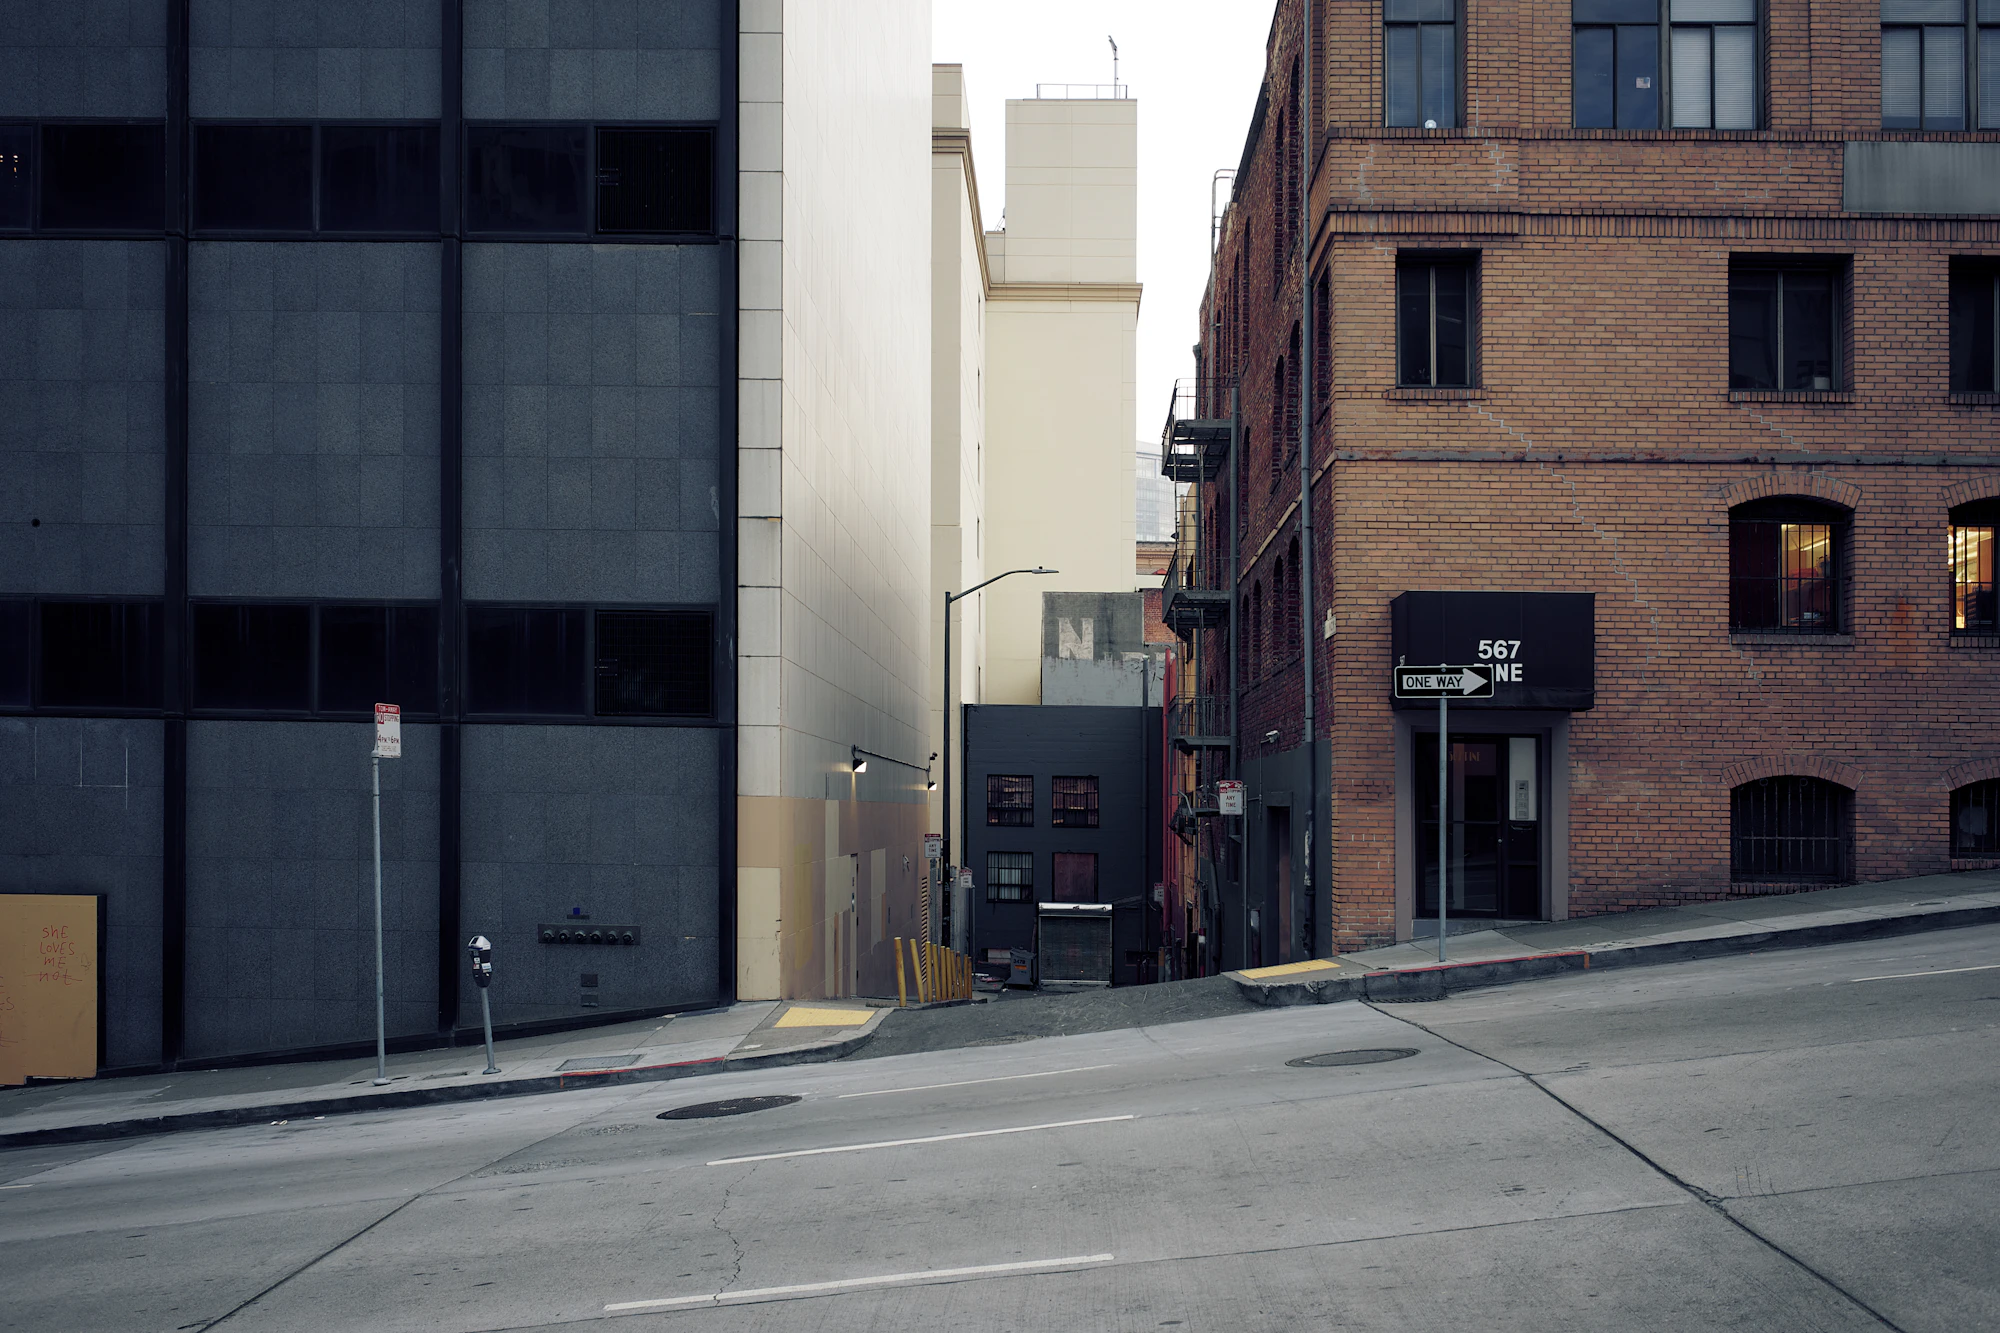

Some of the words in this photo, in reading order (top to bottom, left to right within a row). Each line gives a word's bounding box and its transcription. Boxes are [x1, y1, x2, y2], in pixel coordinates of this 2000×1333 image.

[1477, 640, 1521, 659] 567
[1406, 676, 1431, 688] ONE
[1436, 676, 1463, 688] WAY
[1473, 663, 1523, 682] NE
